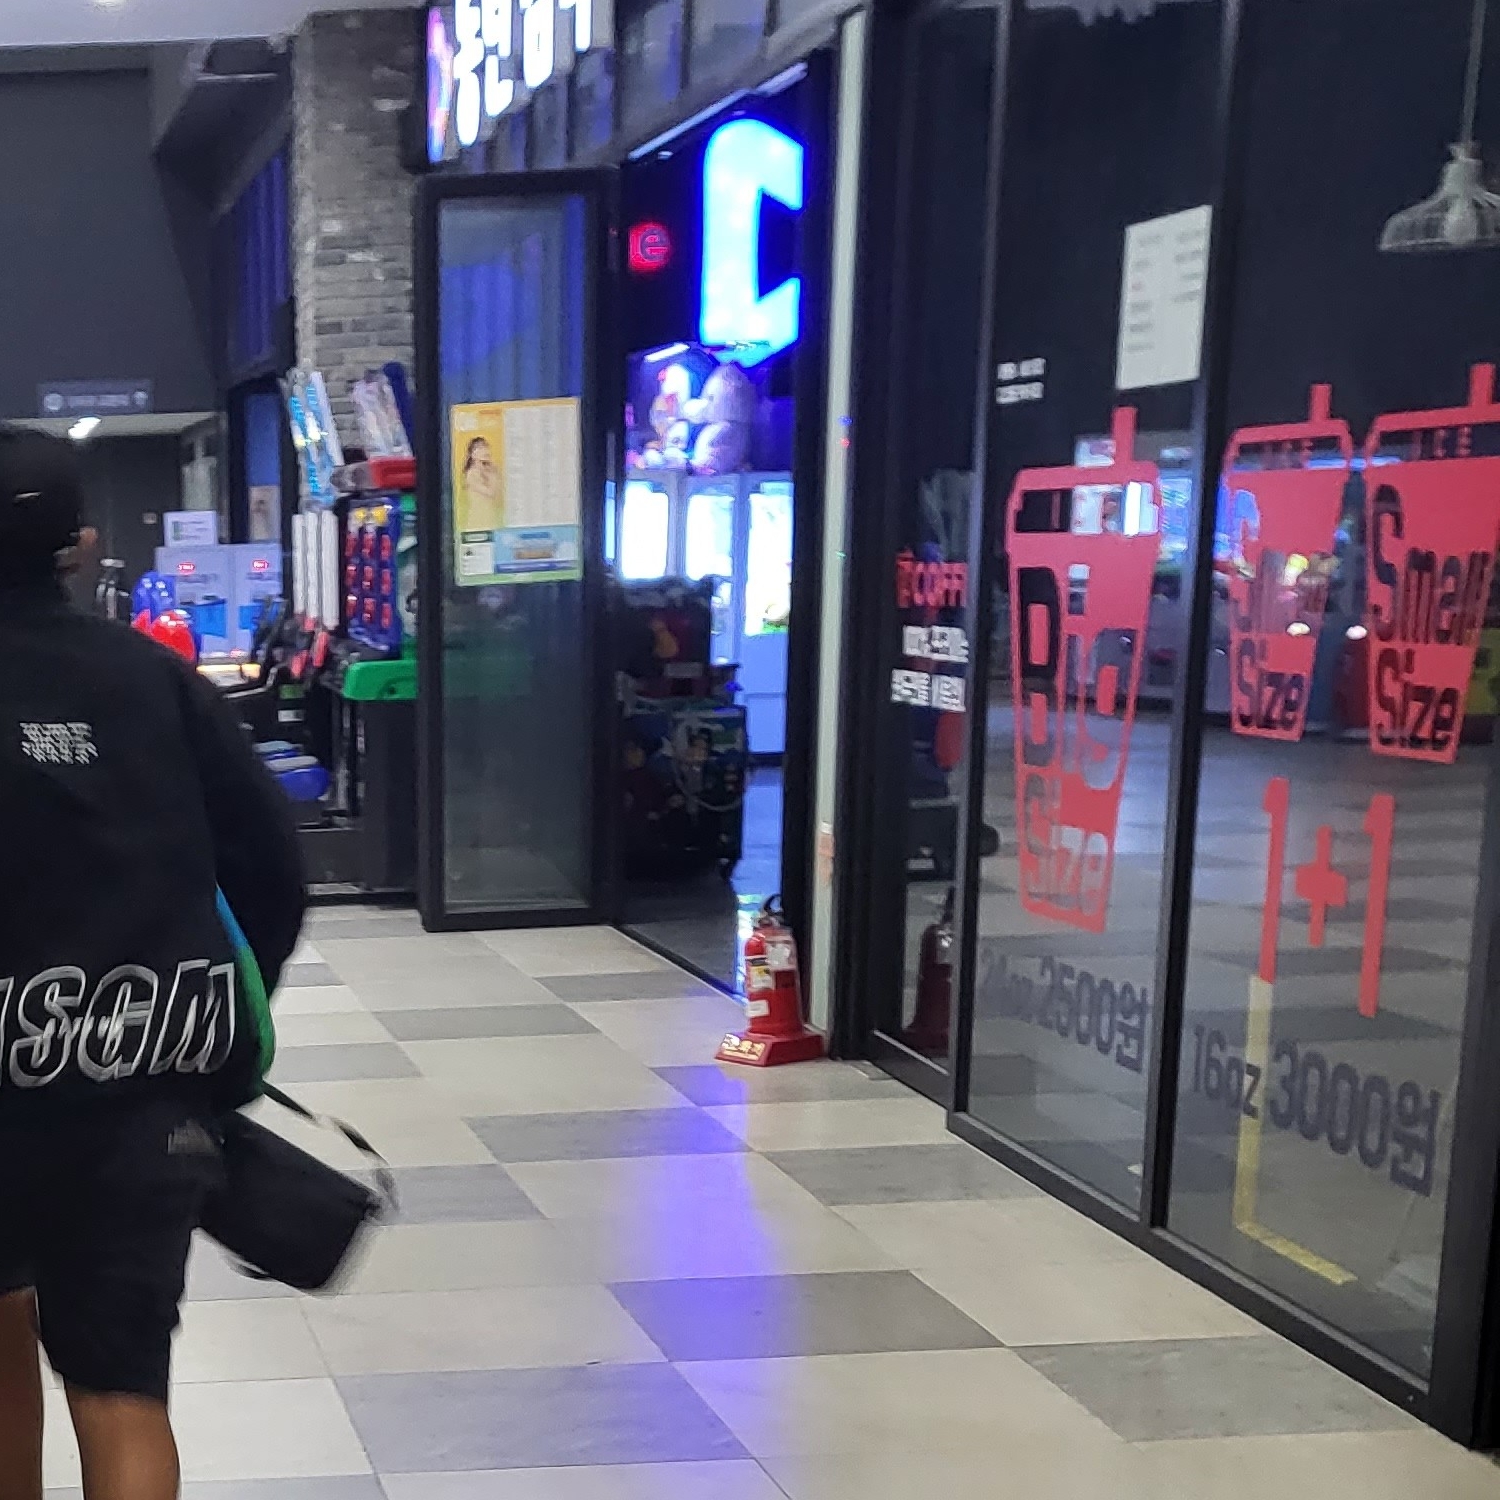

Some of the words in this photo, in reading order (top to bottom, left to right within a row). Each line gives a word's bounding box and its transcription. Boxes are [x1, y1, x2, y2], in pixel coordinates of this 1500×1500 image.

[1371, 485, 1490, 645] Small
[1237, 638, 1306, 731] Size
[1375, 648, 1460, 750] Size
[1023, 774, 1109, 917] Size
[1193, 1024, 1261, 1119] 16oz
[1270, 1039, 1443, 1198] 3000원
